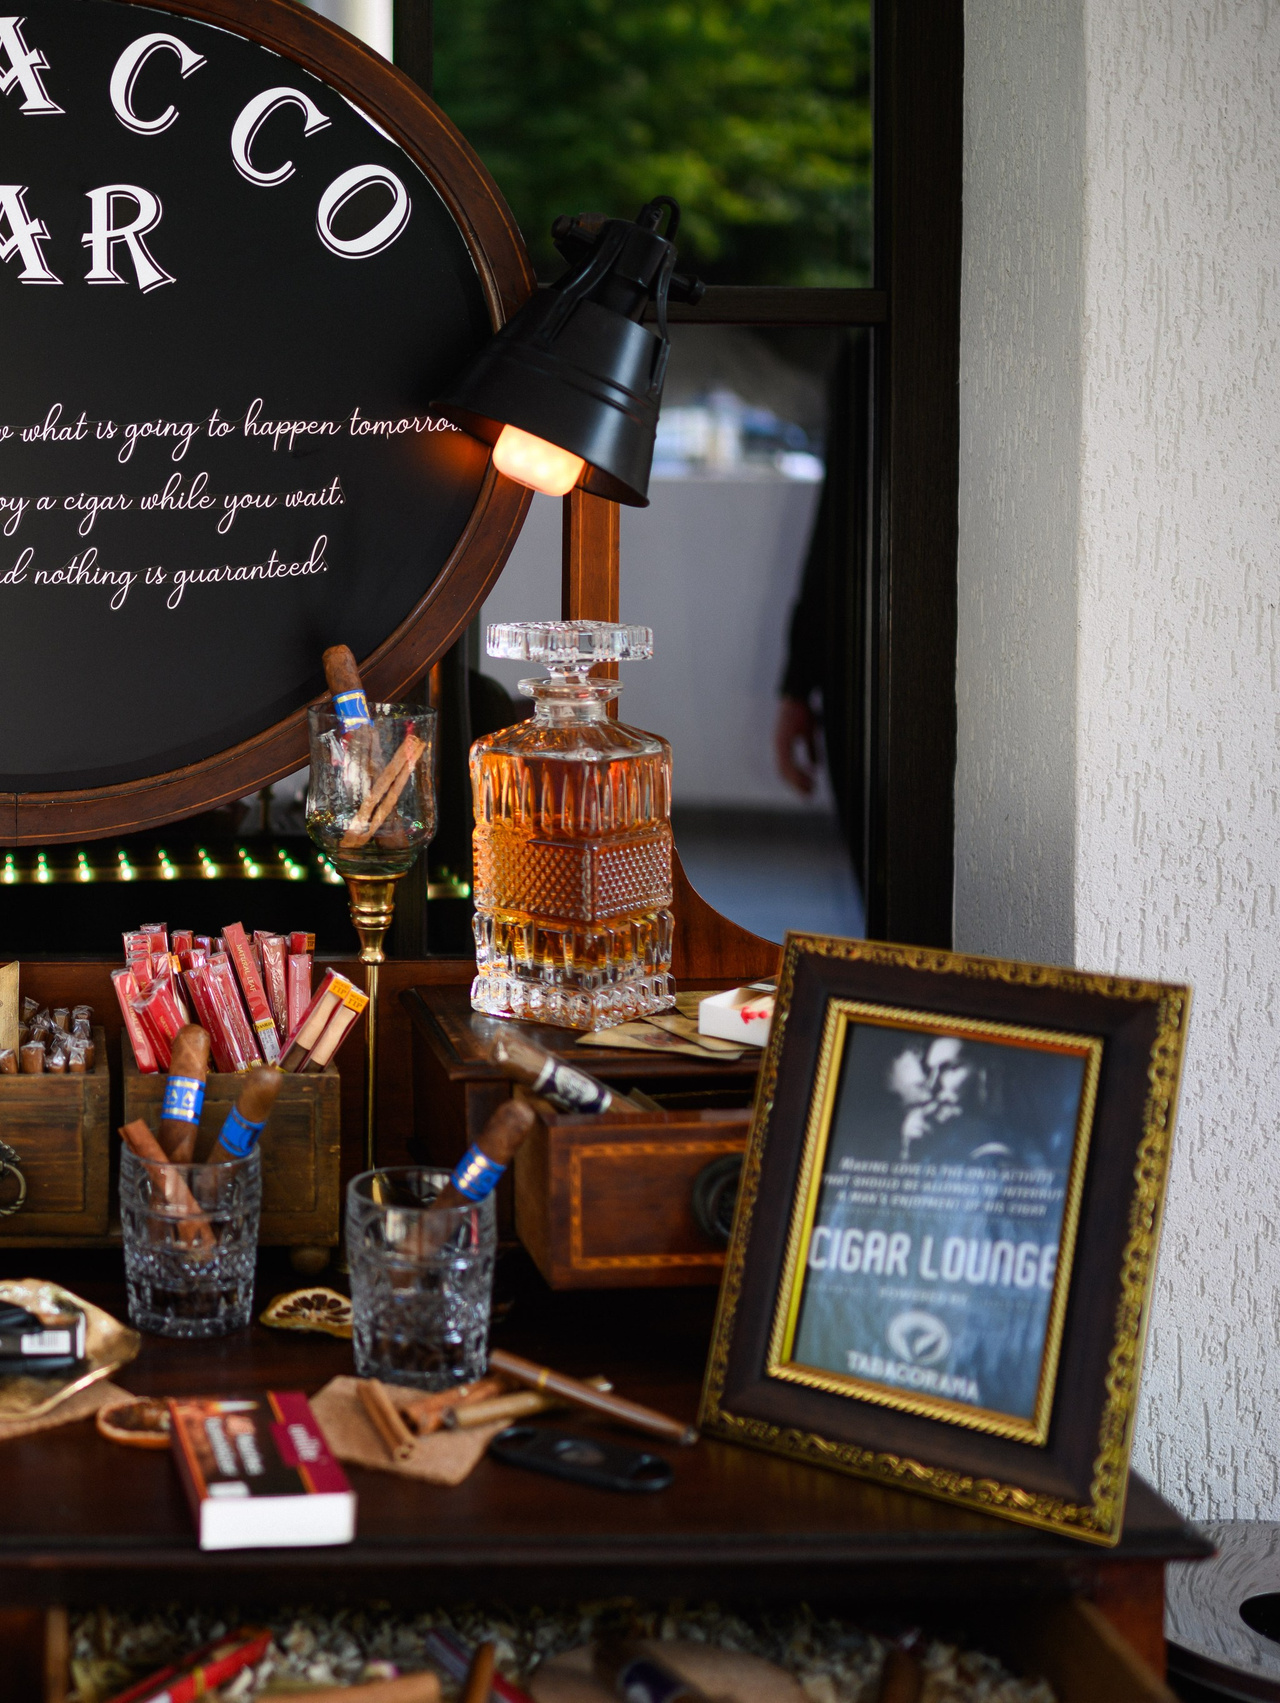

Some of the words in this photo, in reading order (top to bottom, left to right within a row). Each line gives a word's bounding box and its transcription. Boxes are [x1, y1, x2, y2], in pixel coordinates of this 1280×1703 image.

[19, 402, 89, 443] what
[96, 420, 119, 440] is
[118, 419, 200, 464] going
[208, 408, 236, 437] to
[244, 397, 342, 452] happen
[36, 496, 57, 511] a
[63, 492, 134, 538] cigar
[140, 471, 217, 510] while
[216, 493, 278, 535] you
[285, 476, 344, 508] wait.
[33, 547, 138, 611] nothing
[145, 566, 168, 585] is
[166, 534, 328, 610] guaranteed.
[235, 944, 249, 974] NATURAL
[246, 976, 257, 993] LEAF
[332, 984, 348, 996] TIP
[348, 998, 364, 1009] TIP
[808, 1224, 913, 1279] CIGAR
[918, 1233, 1059, 1291] LOUNGE
